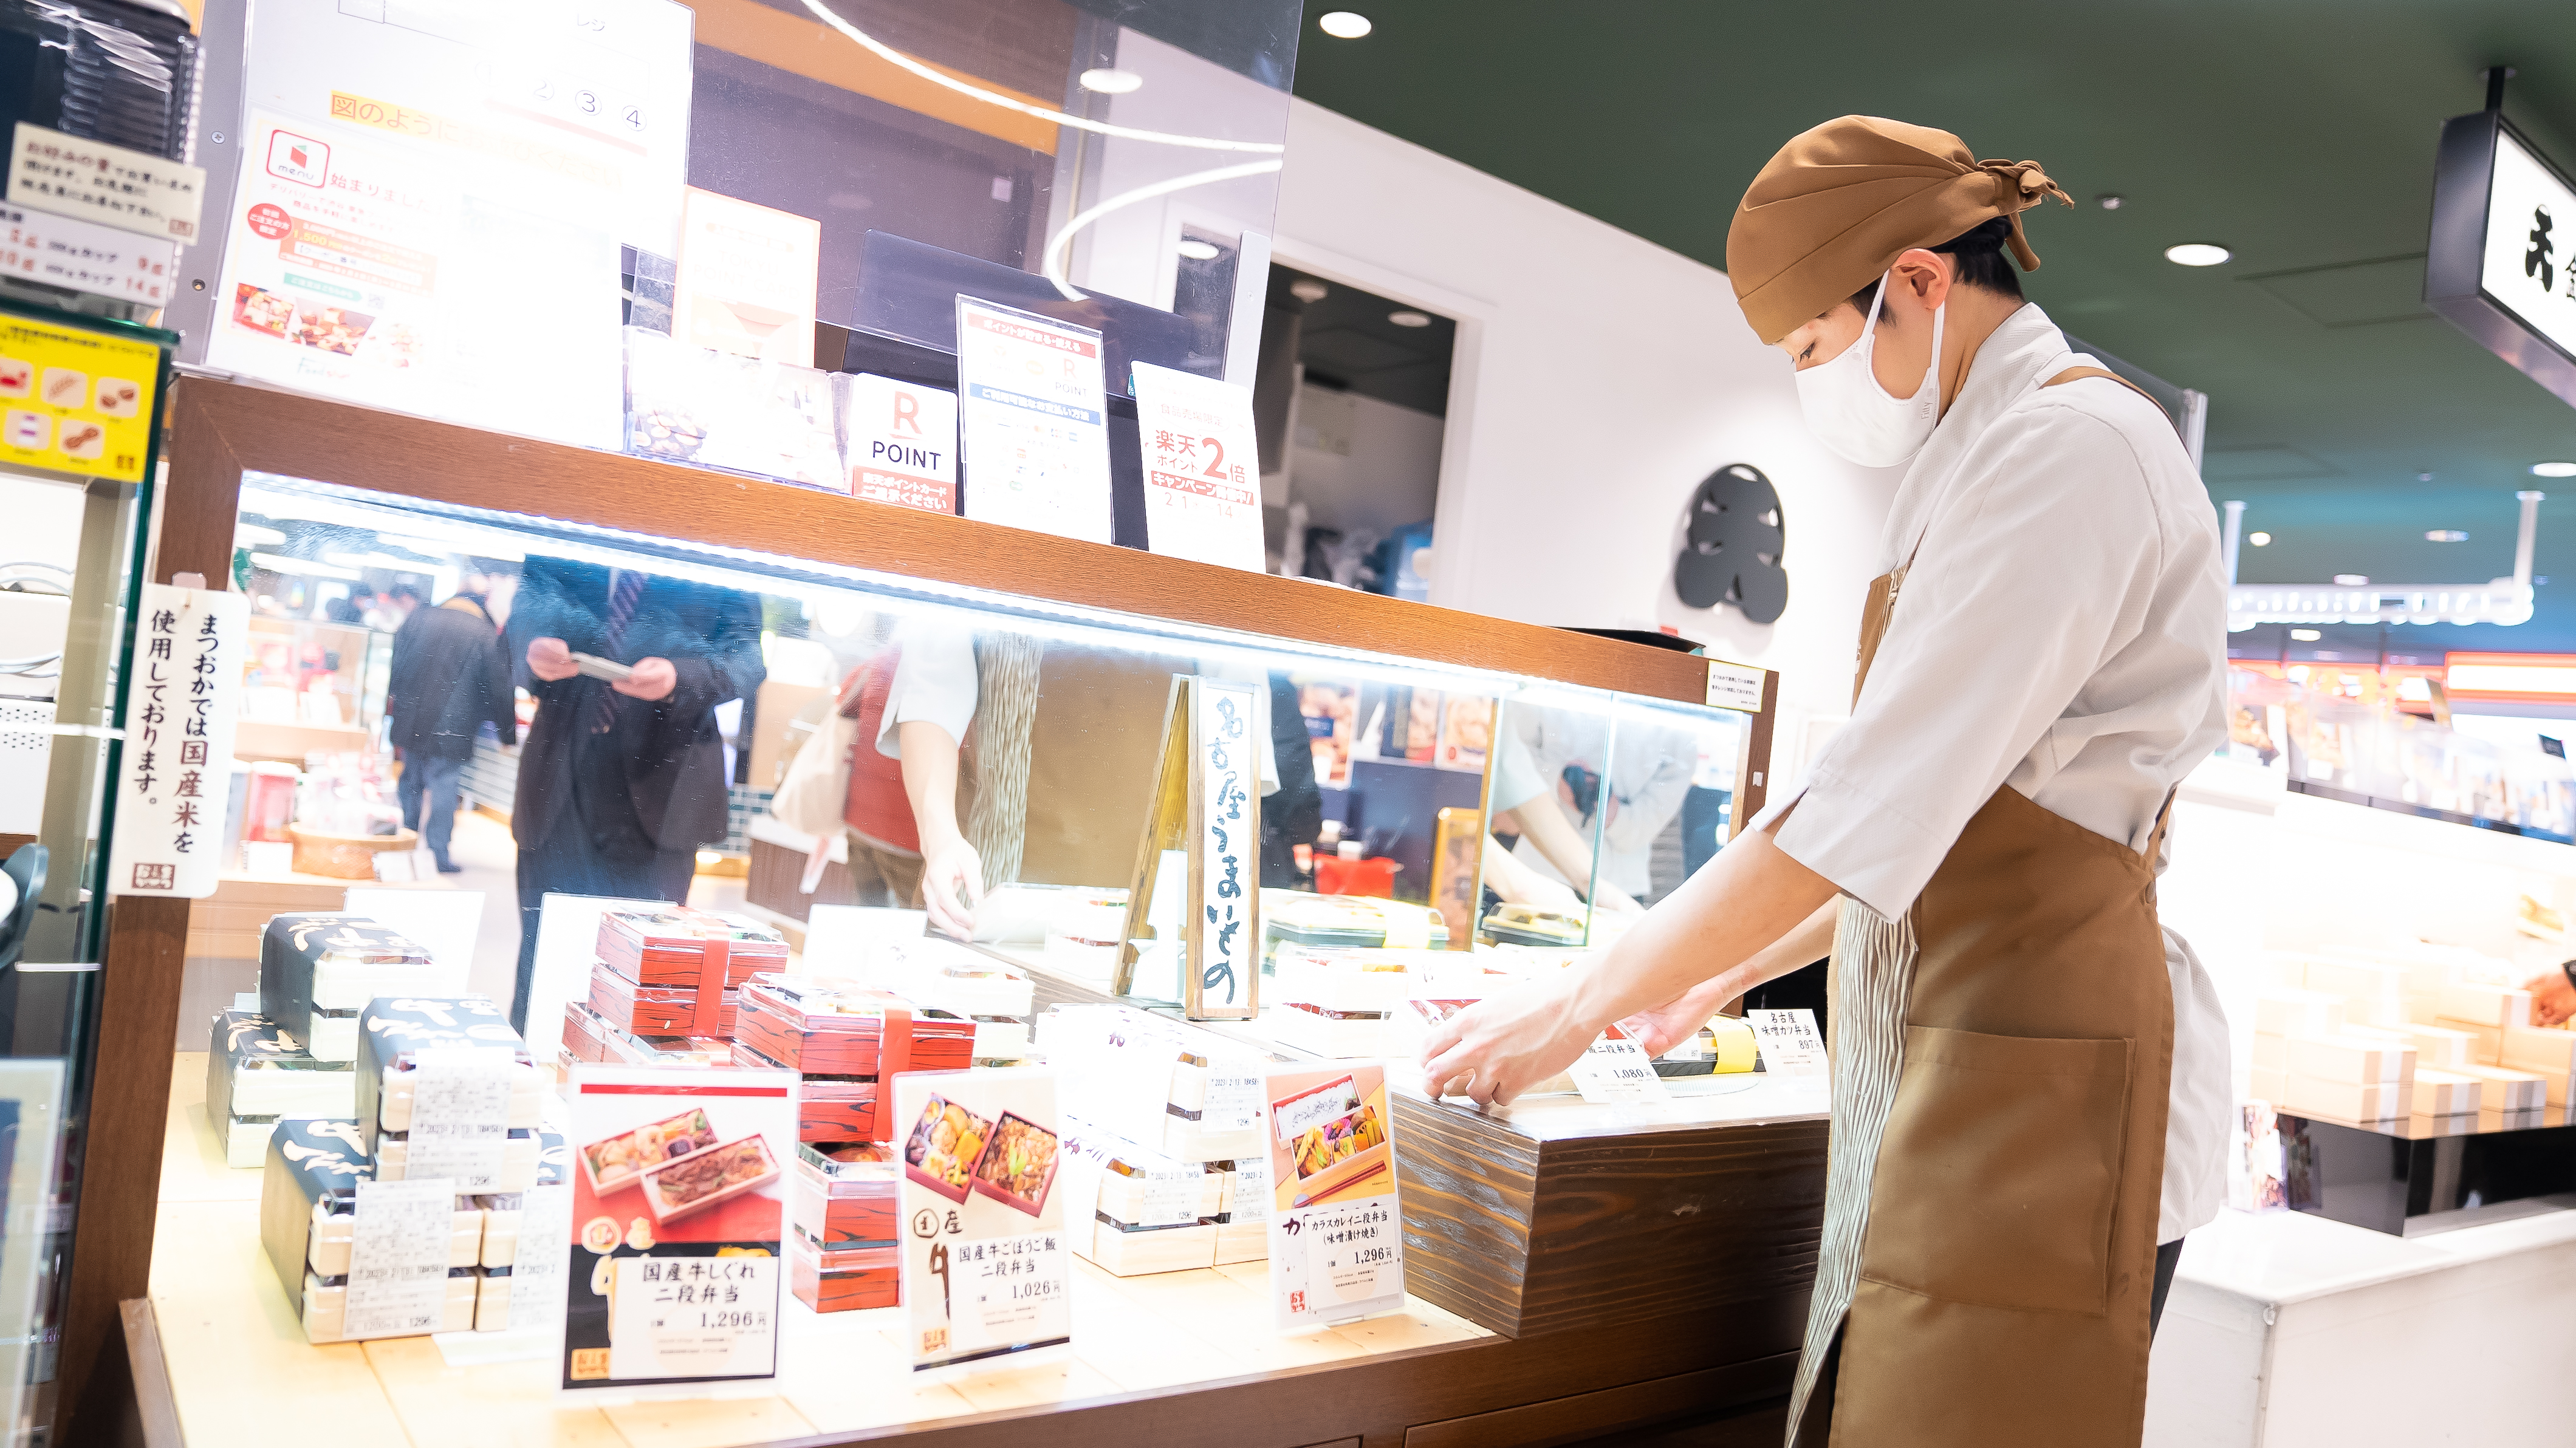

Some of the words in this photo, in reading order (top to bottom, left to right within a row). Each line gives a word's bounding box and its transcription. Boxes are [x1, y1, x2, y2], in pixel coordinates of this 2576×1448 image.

[278, 165, 314, 180] menu
[1055, 382, 1088, 397] POINT
[894, 391, 923, 435] R
[1160, 403, 1224, 427] 食品売場限定
[1156, 430, 1196, 457] 楽天
[873, 441, 941, 470] POINT
[1157, 455, 1197, 473] ポイント
[863, 473, 947, 497] 楽天ポイントカード
[134, 609, 177, 805] 使用しております。
[171, 613, 219, 854] まつおかでは国産米を
[1770, 1011, 1797, 1023] 名古屋
[1761, 1024, 1811, 1036] 味噌カツ弁当
[1312, 1210, 1388, 1231] カラスカレイ二段弁当
[959, 1236, 1057, 1263] 国産牛ごぼうご飯
[642, 1260, 755, 1283] 国産牛しぐれ
[981, 1257, 1035, 1277] 二段弁当
[653, 1282, 739, 1305] 二段弁当
